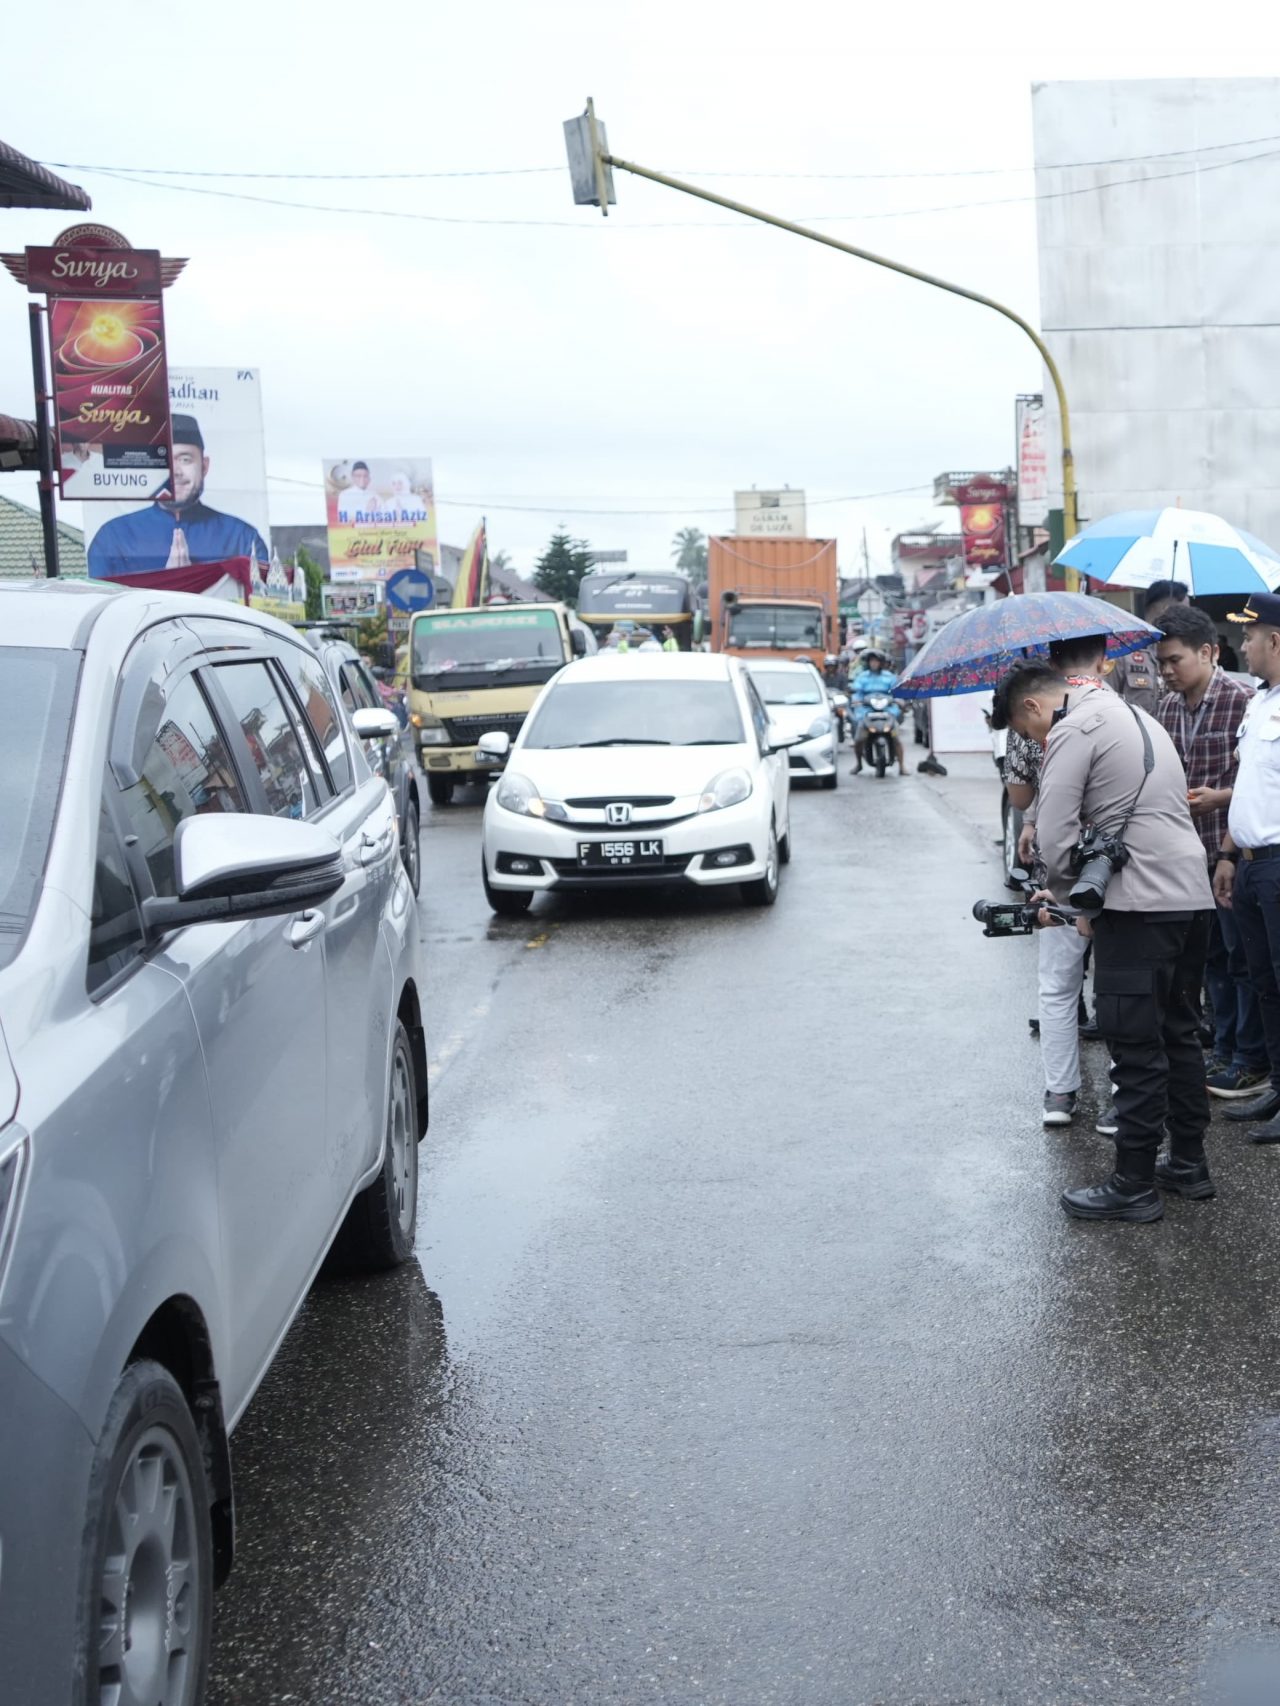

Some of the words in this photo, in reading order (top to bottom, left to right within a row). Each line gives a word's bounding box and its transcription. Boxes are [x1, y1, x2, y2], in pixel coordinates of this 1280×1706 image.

[52, 253, 138, 288] Surya
[91, 385, 133, 395] KUALITAS
[78, 402, 151, 432] Surya
[93, 473, 148, 487] BUYUNG
[355, 508, 398, 523] Arisal
[400, 507, 428, 522] Aziz
[580, 843, 591, 858] F
[601, 842, 635, 857] 1556
[640, 841, 660, 856] LK
